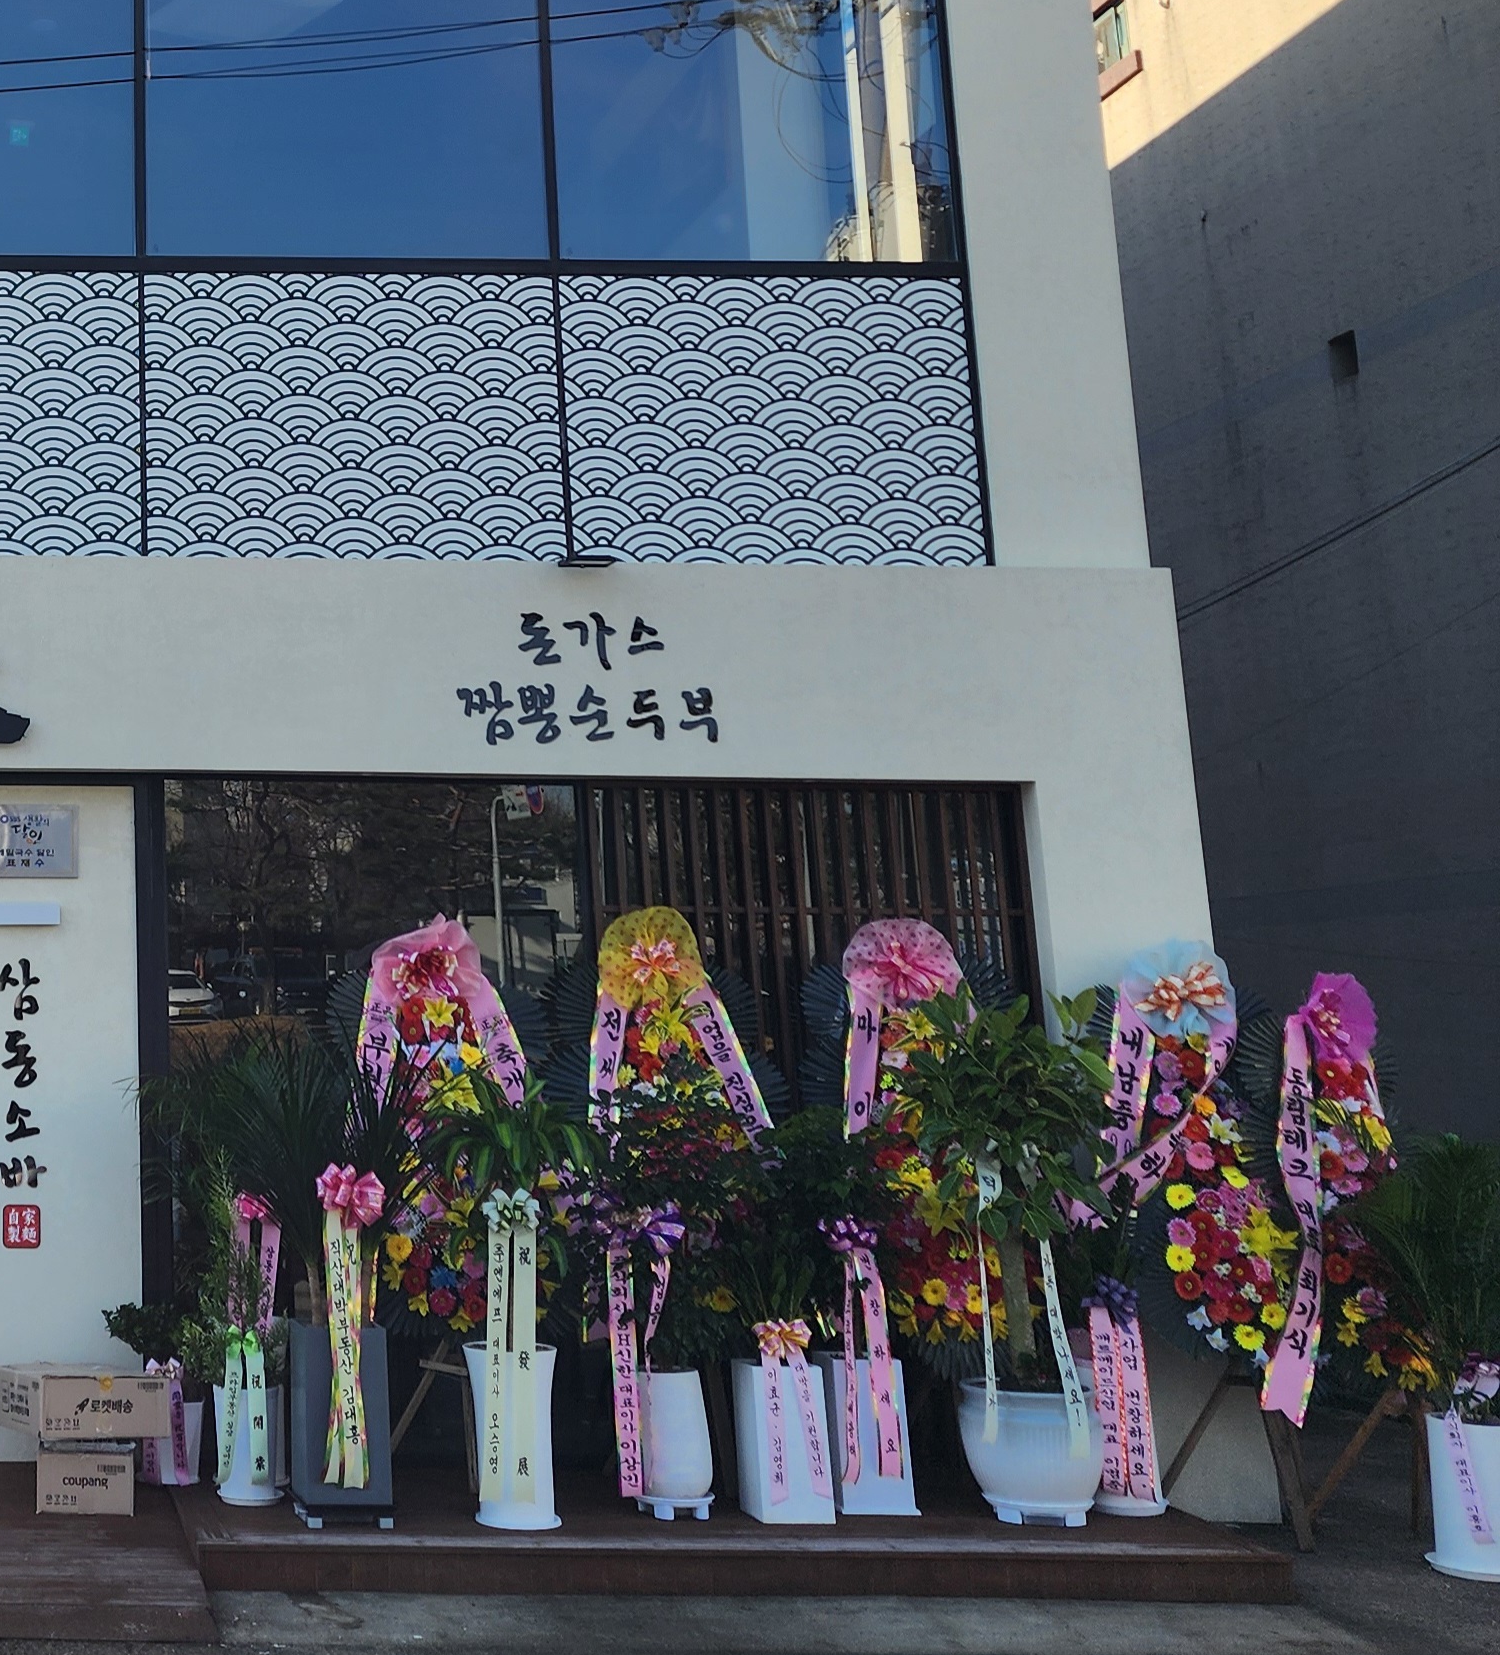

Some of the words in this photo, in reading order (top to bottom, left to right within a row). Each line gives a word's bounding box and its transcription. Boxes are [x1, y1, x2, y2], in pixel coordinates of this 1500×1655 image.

[518, 612, 665, 670] 돈가스
[456, 681, 719, 745] 짬뽕순두부
[1122, 1337, 1139, 1371] 사업
[90, 1399, 133, 1414] 로켓배송
[62, 1476, 108, 1489] coupang
